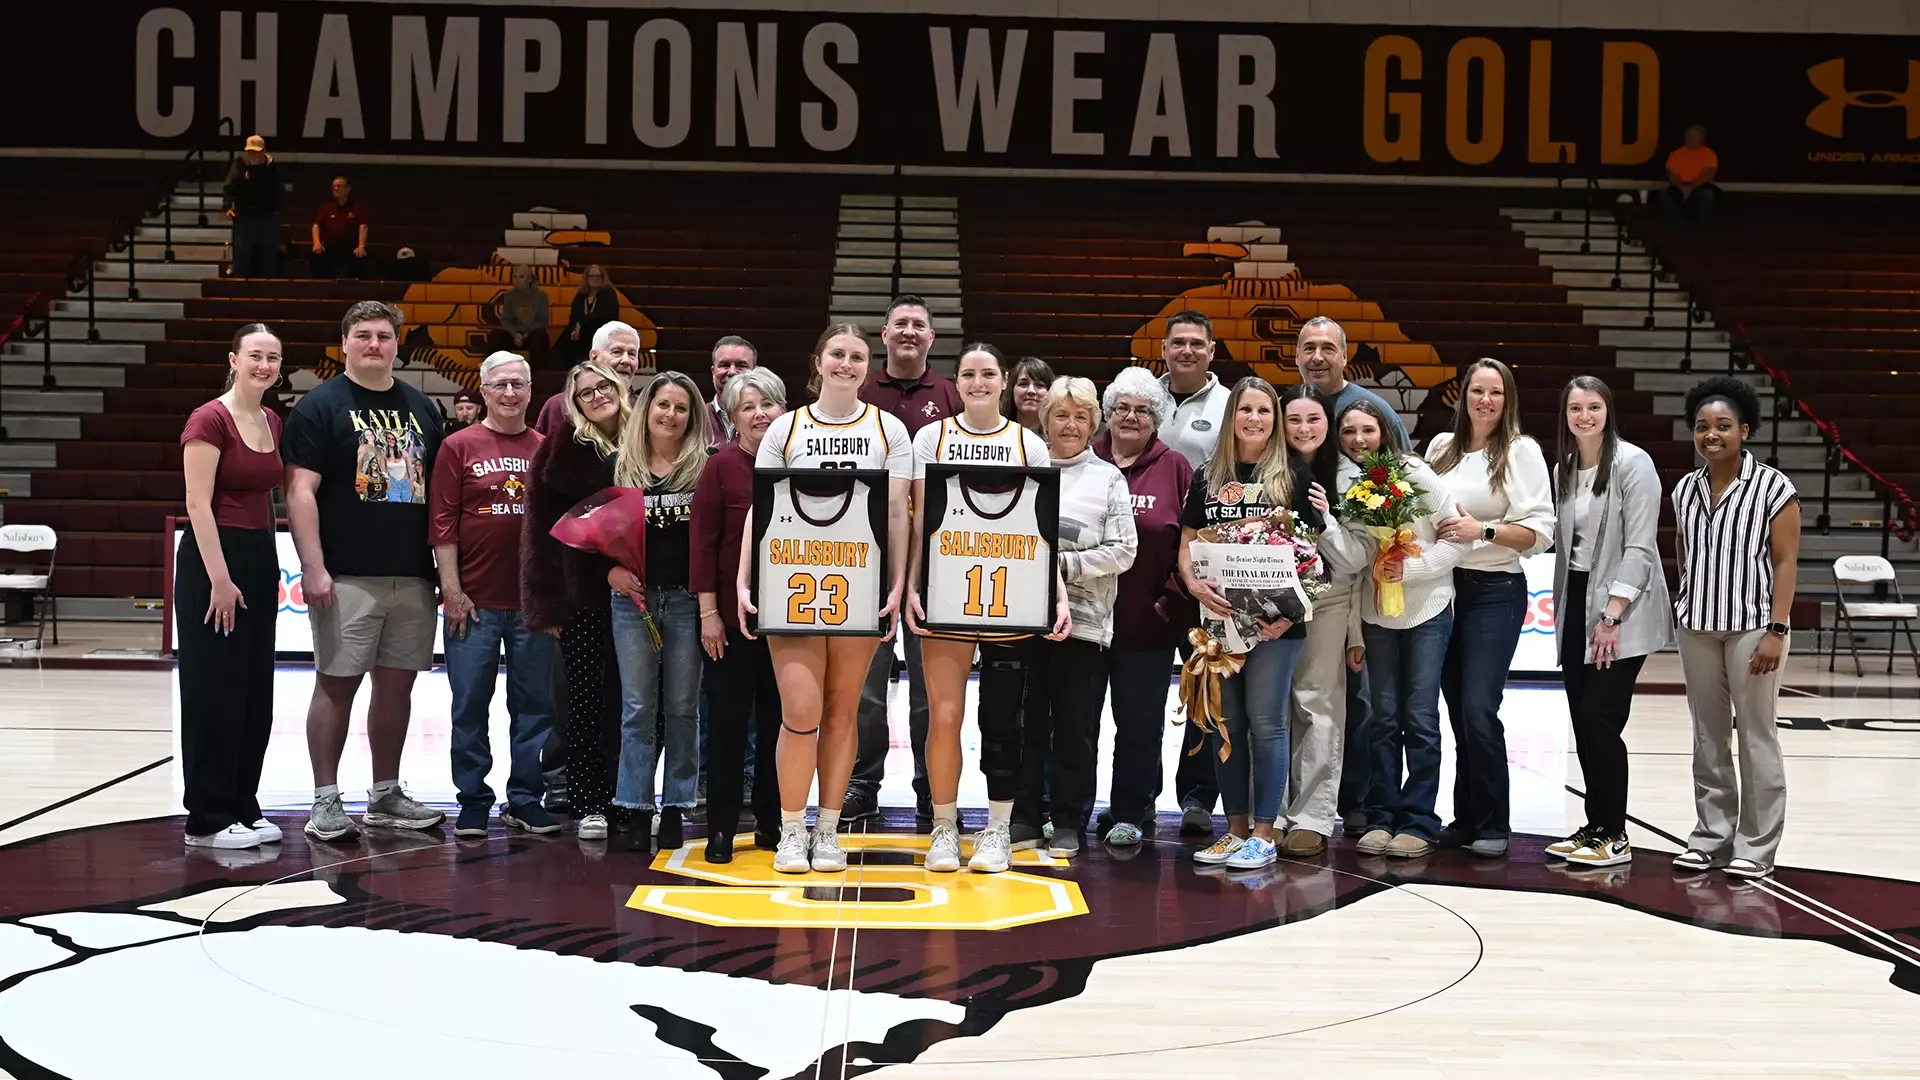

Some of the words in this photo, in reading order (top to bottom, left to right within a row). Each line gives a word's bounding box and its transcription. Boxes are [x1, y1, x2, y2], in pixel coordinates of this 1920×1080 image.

[135, 7, 859, 152] CHAMPIONS
[929, 26, 1280, 159] WEAR
[1363, 35, 1660, 165] GOLD
[1808, 152, 1865, 161] UNDER
[349, 408, 423, 434] KAYLA
[806, 437, 871, 456] SALISBURY
[949, 444, 1011, 462] SALISBURY
[472, 456, 530, 477] SALISBU
[491, 503, 511, 515] SEA
[1205, 506, 1218, 520] MY
[1221, 506, 1242, 518] SEA
[770, 538, 869, 568] SALISBURY
[940, 530, 1038, 560] SALISBURY
[1221, 569, 1236, 577] THE
[1237, 570, 1260, 578] FINAL
[1260, 570, 1293, 578] BUZZER
[787, 572, 849, 625] 23
[963, 565, 1008, 617] 11
